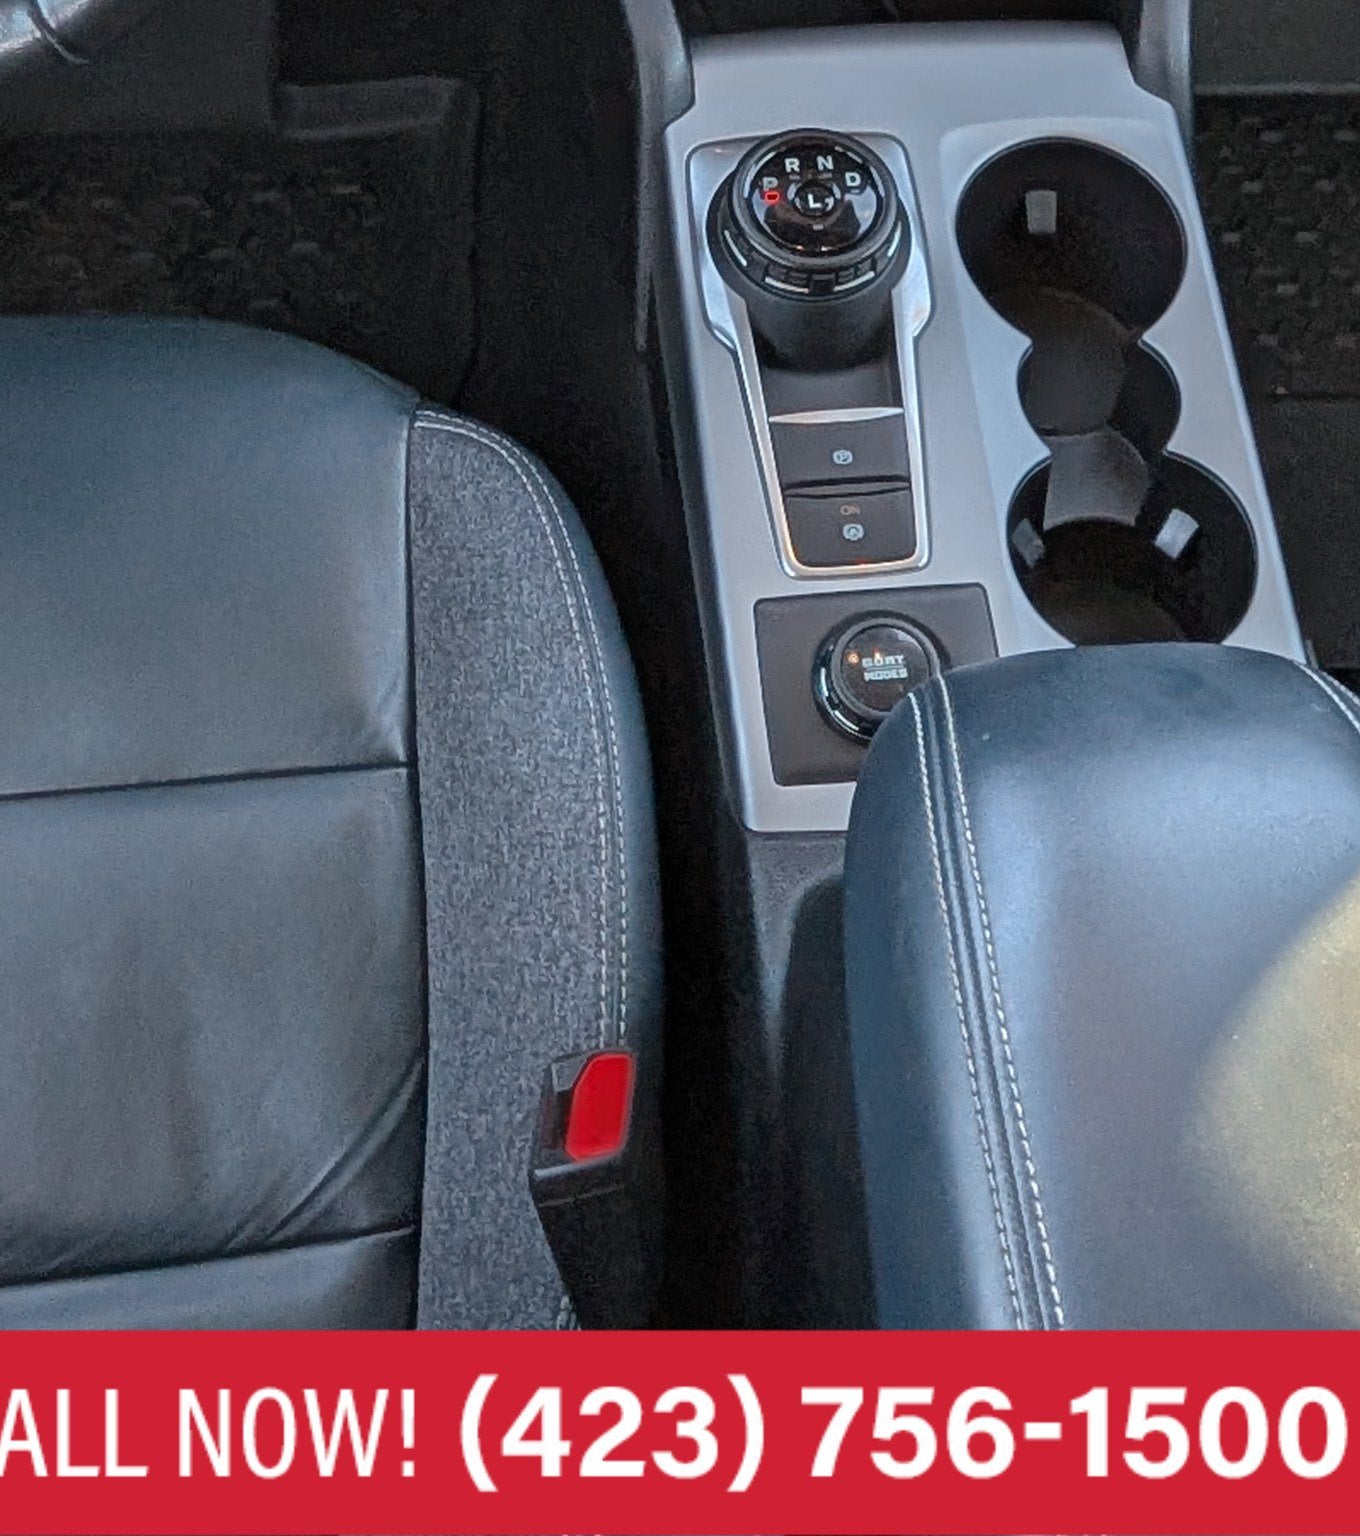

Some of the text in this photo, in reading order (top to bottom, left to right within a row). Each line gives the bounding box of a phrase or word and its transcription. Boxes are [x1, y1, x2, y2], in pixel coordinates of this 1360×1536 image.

[784, 155, 834, 173] R N
[762, 176, 778, 193] P
[845, 172, 861, 188] D
[807, 193, 824, 209] L
